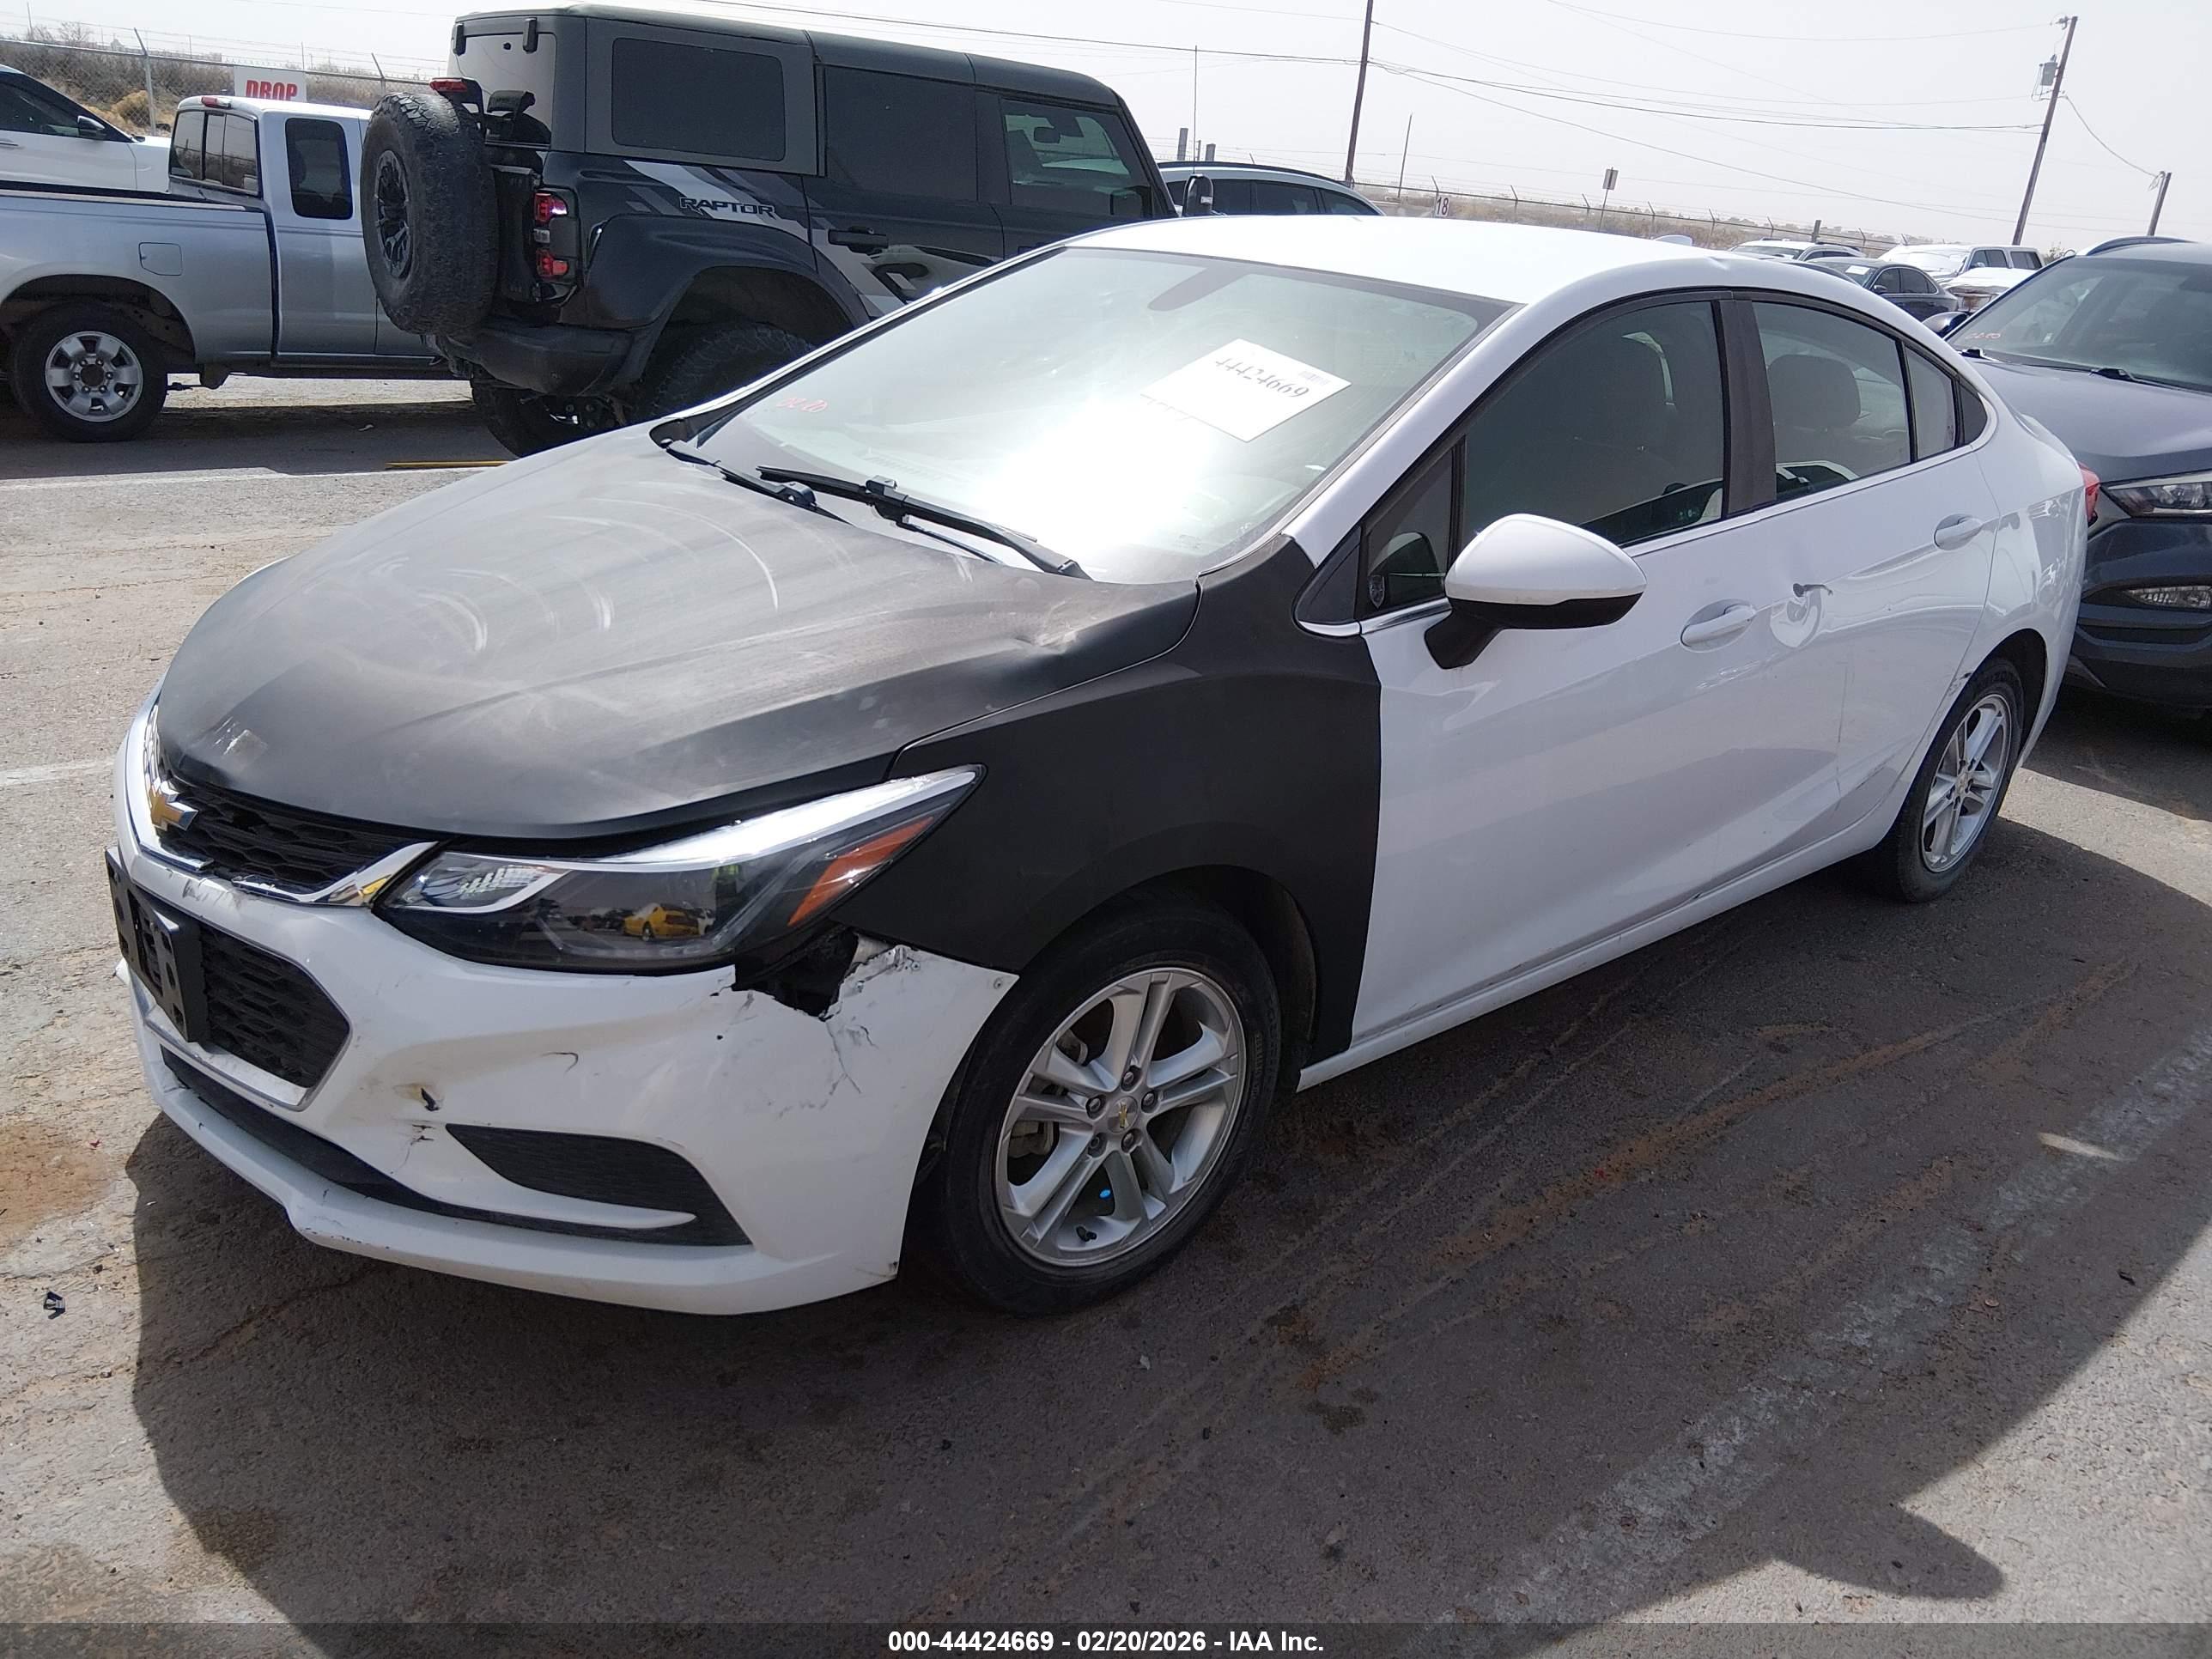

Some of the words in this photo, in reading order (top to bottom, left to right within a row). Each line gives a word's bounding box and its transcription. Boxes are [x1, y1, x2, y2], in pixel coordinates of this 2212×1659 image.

[246, 79, 298, 101] DROP
[679, 197, 778, 220] RAPTOR
[1437, 197, 1449, 216] 18
[1215, 357, 1310, 398] 44424669
